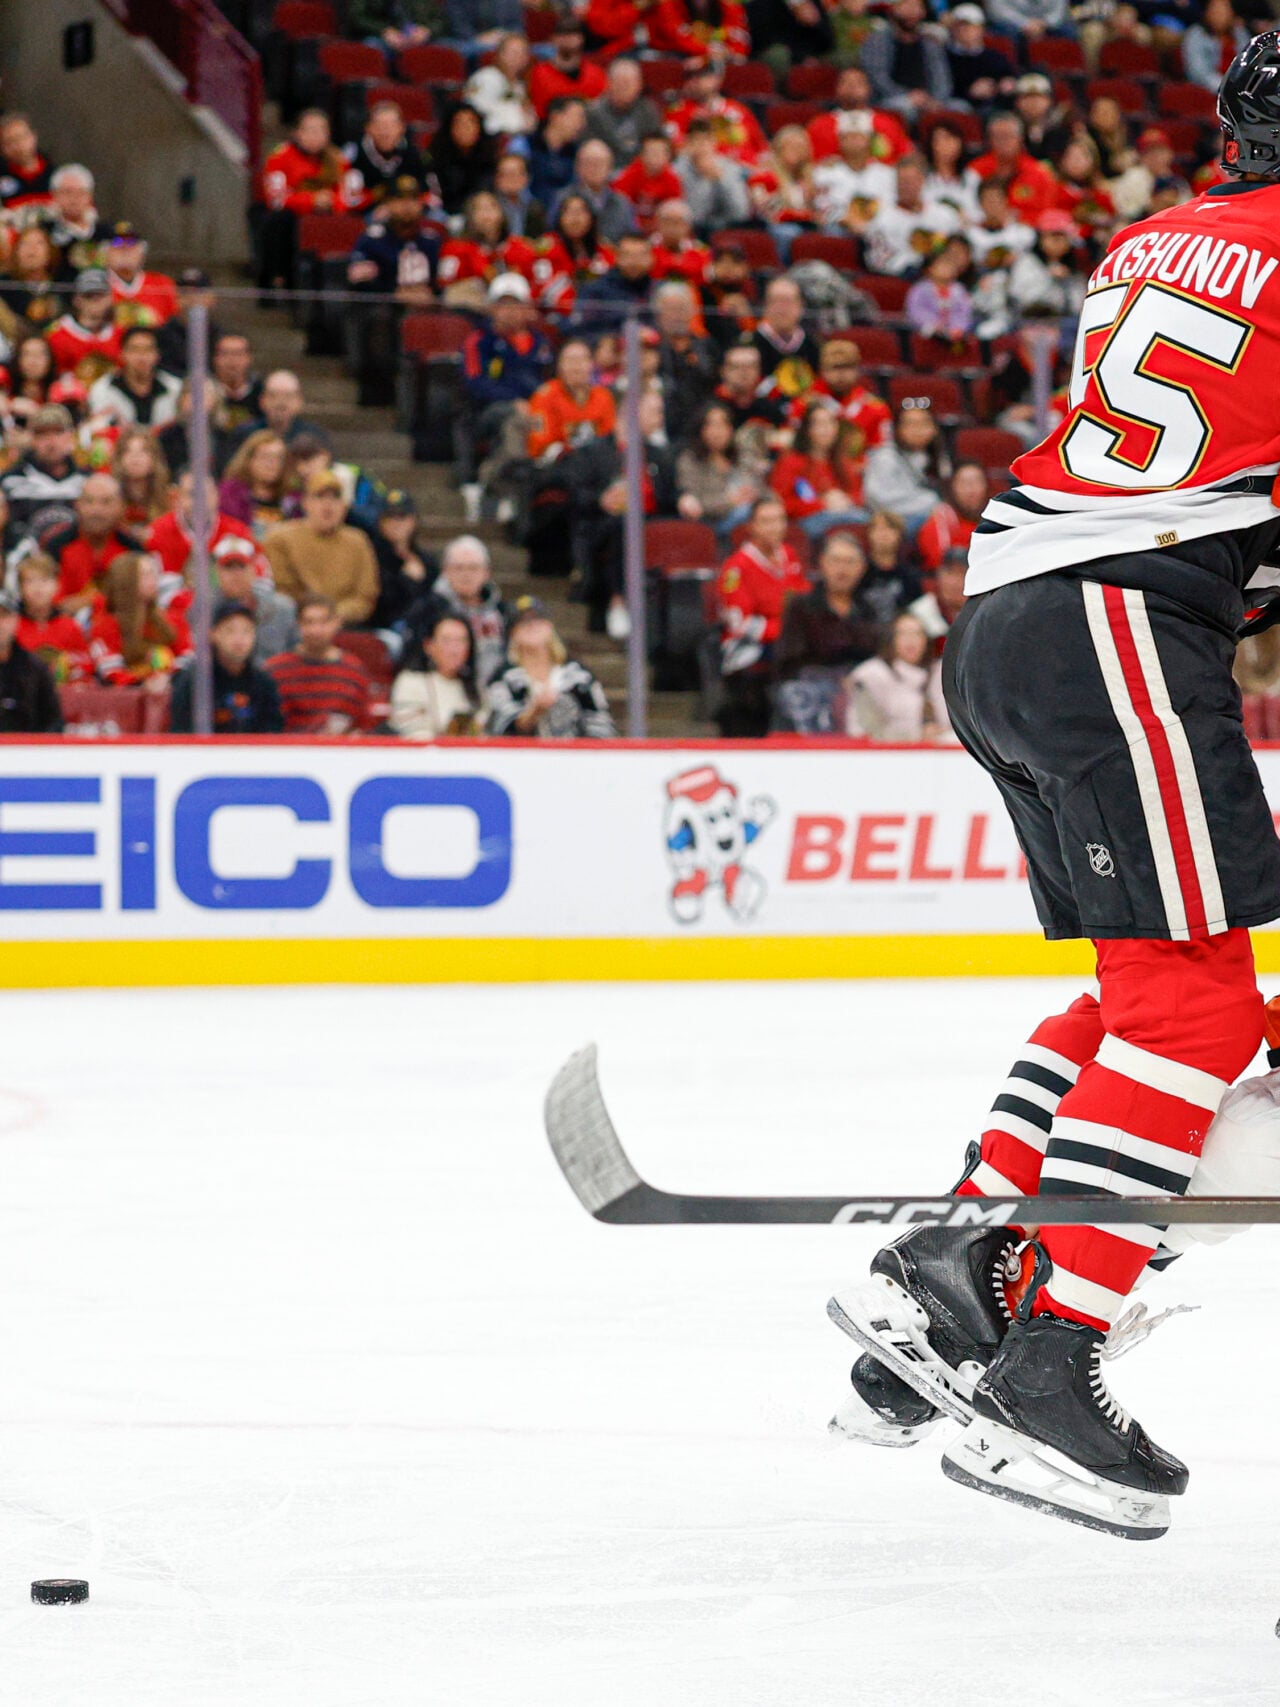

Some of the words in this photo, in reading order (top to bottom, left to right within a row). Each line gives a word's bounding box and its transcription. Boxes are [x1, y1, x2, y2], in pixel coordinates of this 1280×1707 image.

[1157, 532, 1177, 546] 100
[785, 815, 1030, 882] BELL
[831, 1202, 1019, 1225] CCM
